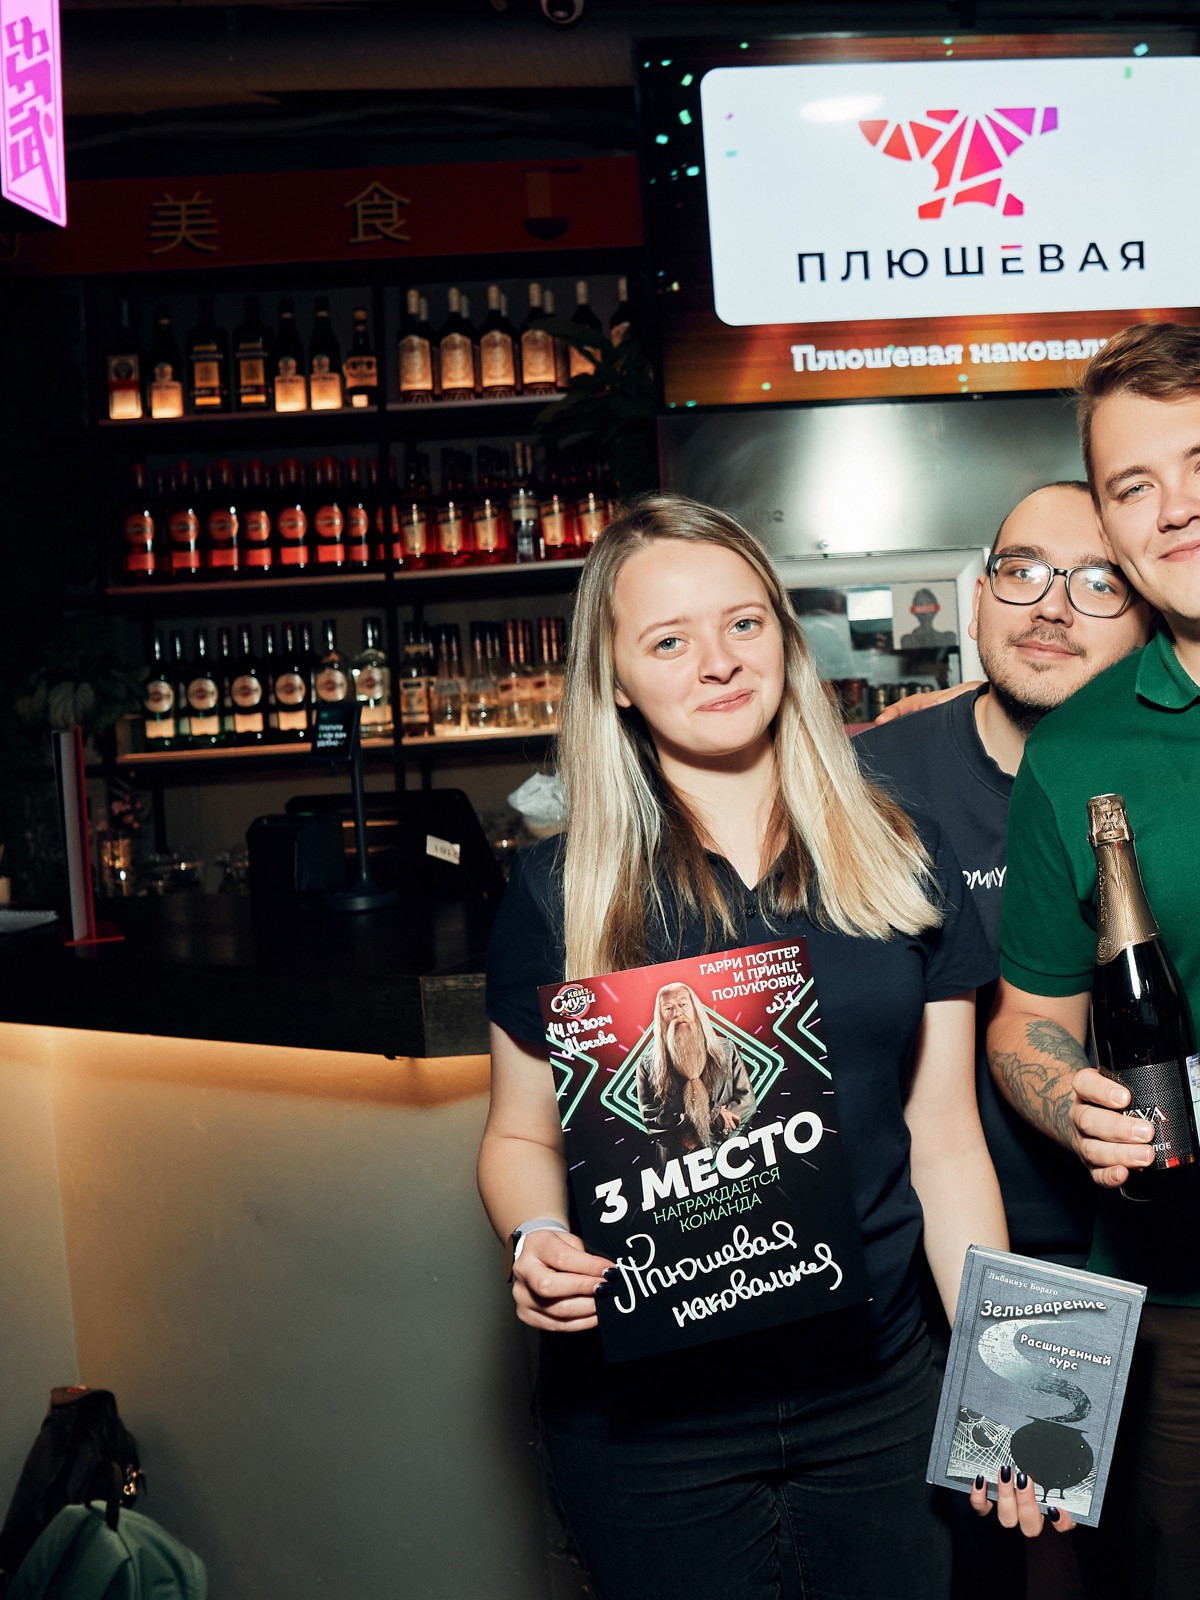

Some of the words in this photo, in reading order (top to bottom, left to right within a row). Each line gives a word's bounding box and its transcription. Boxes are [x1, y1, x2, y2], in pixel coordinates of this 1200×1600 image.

[797, 241, 1147, 283] ПЛЮШЕВАЯ
[790, 344, 964, 372] Плюшевая
[969, 338, 1108, 365] наковал
[699, 957, 743, 976] ГАРРИ
[745, 946, 800, 966] ПОТТЕР
[733, 972, 745, 983] И
[747, 960, 802, 980] ПРИНЦ-
[551, 993, 597, 1013] Смузи
[567, 988, 589, 998] КВИЗ
[711, 973, 805, 1002] ПОЛУКРОВКА
[595, 1178, 629, 1223] 3
[641, 1111, 823, 1211] МЕСТО
[653, 1166, 781, 1224] НАГРАЖДАЕТСЯ
[680, 1192, 762, 1233] КОМАНДА
[614, 1221, 797, 1313] Плюшевая
[980, 1300, 1106, 1317] Зельеварение
[1020, 1334, 1111, 1366] Расширенный
[1049, 1356, 1078, 1370] курс
